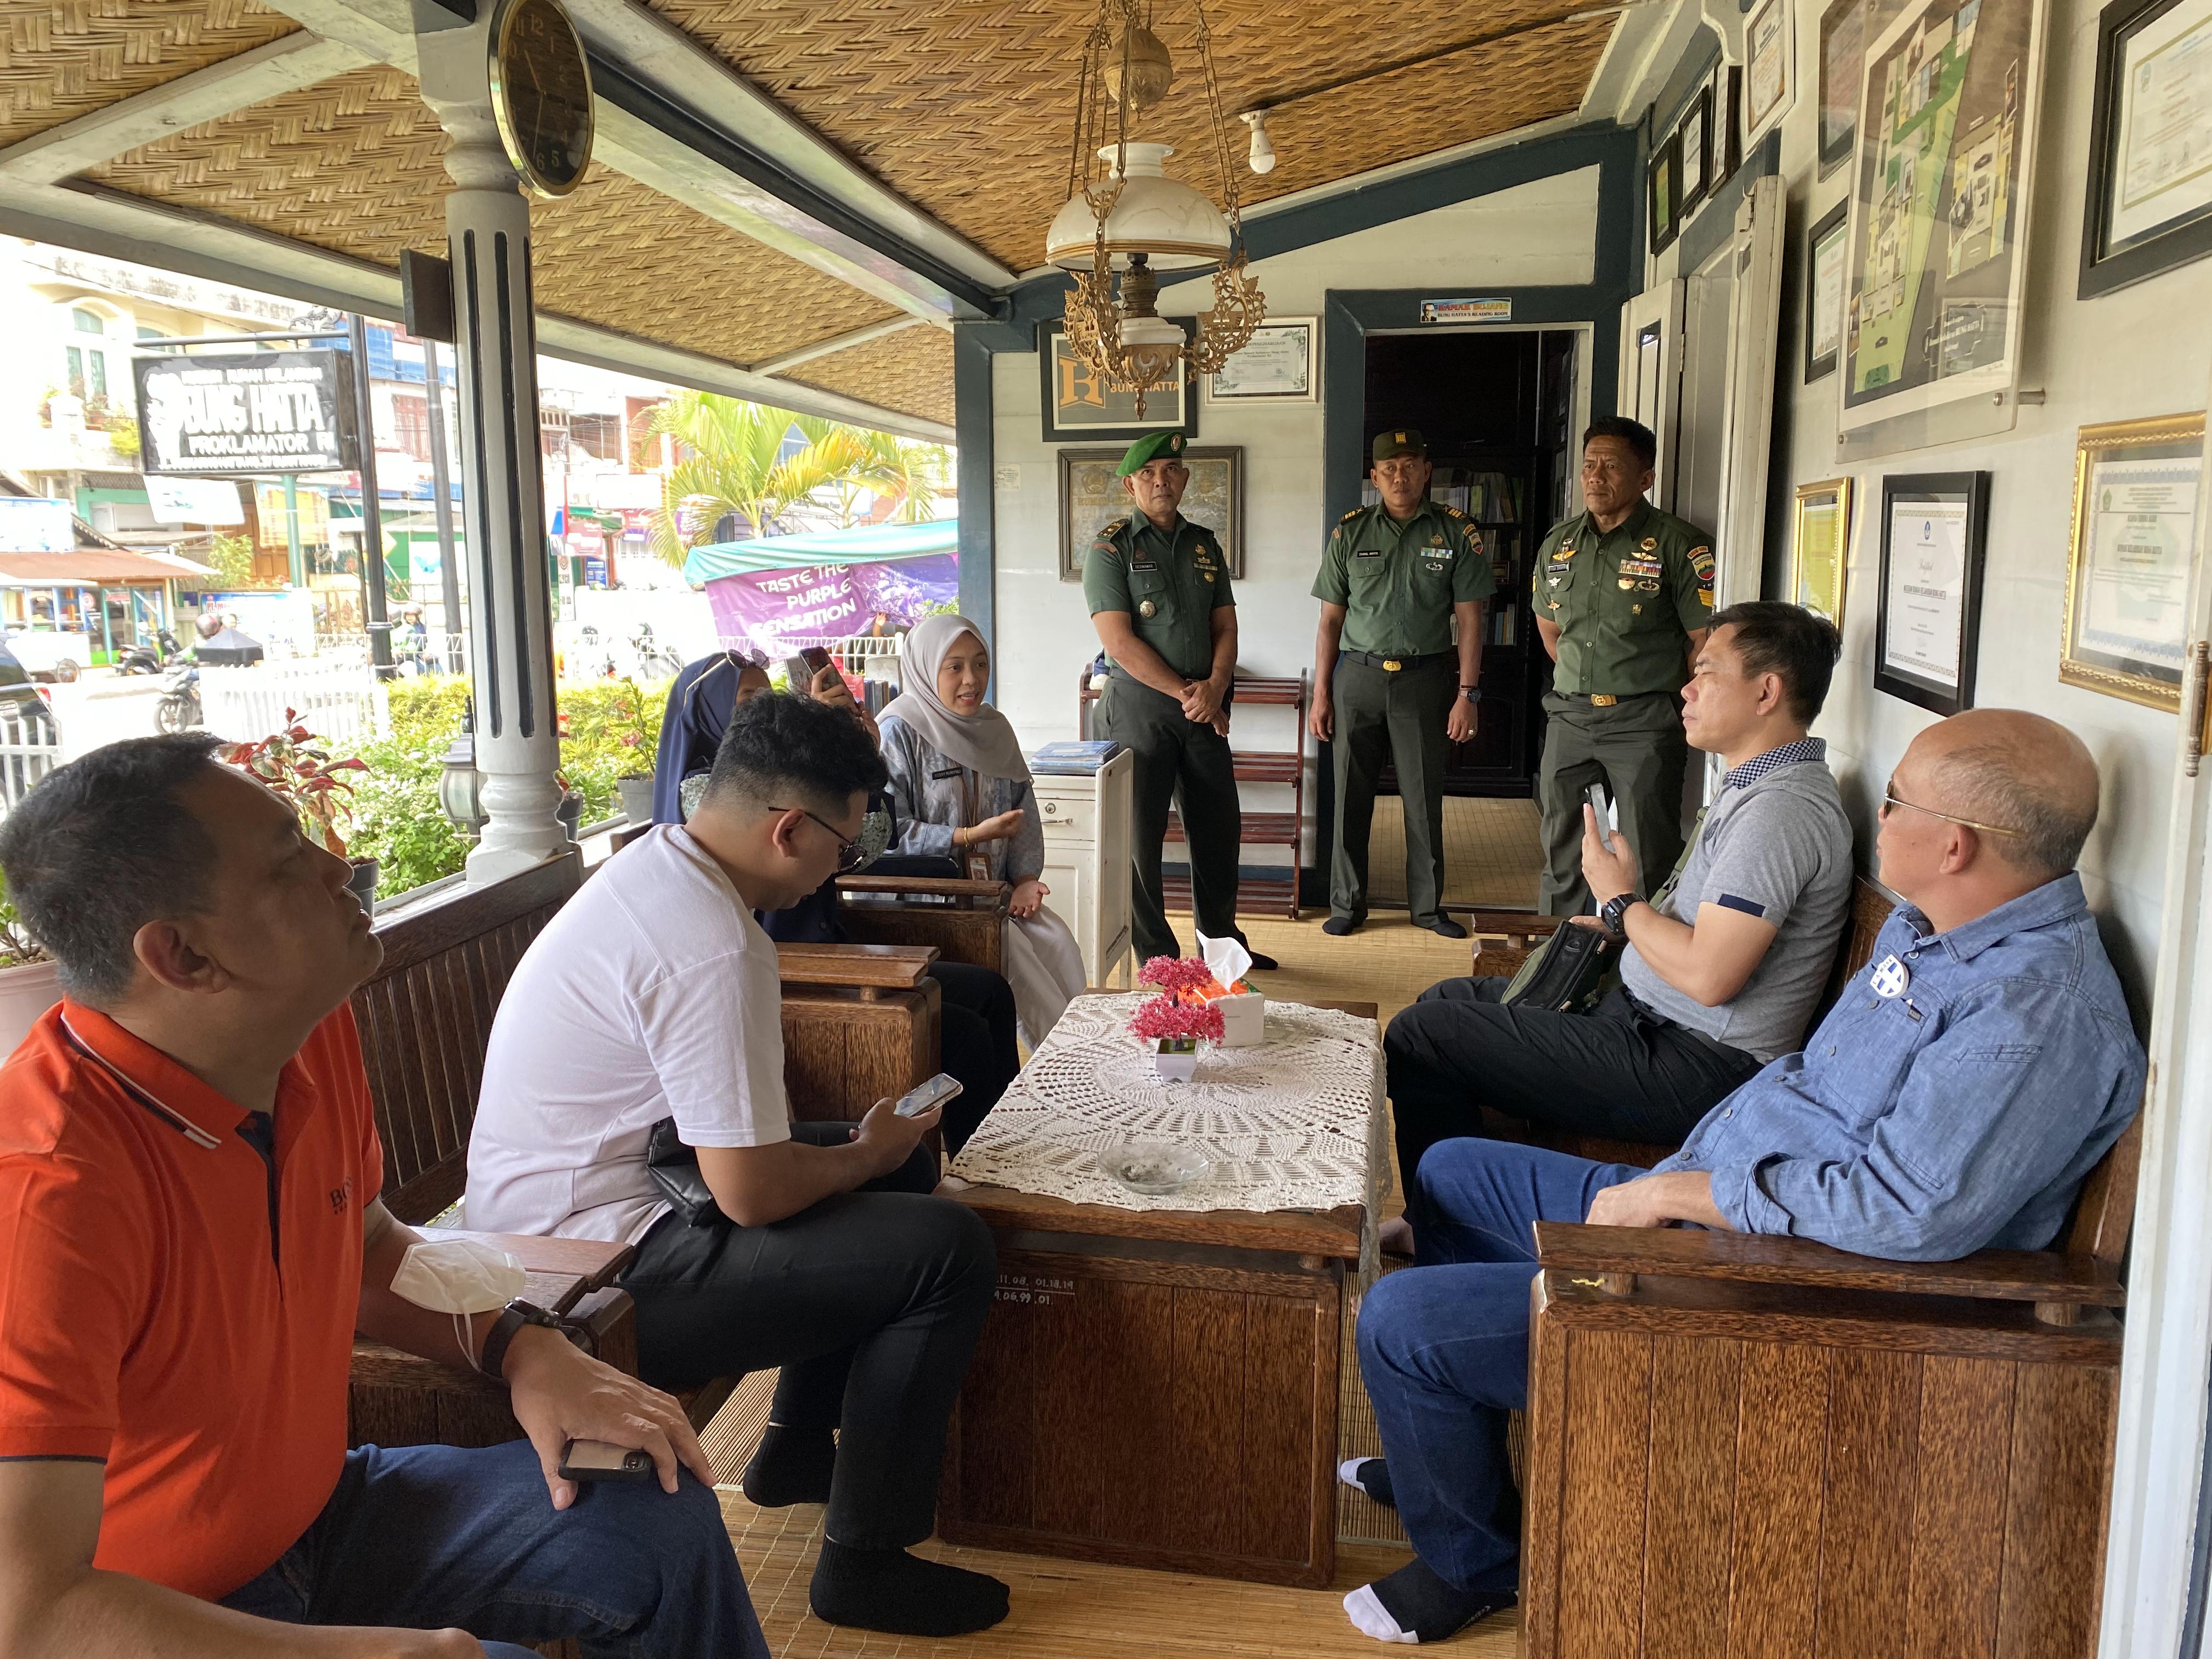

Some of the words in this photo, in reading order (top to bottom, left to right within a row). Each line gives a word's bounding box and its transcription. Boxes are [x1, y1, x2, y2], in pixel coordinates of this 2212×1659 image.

[535, 153, 545, 171] 6
[551, 150, 560, 168] 5
[184, 384, 248, 433] BUNG
[249, 382, 325, 432] HATTA
[188, 433, 309, 455] PROKLAMATOR
[755, 569, 814, 593] TASTE
[814, 563, 850, 577] THE
[787, 577, 851, 610] PURPLE
[749, 597, 857, 636] SENSATION
